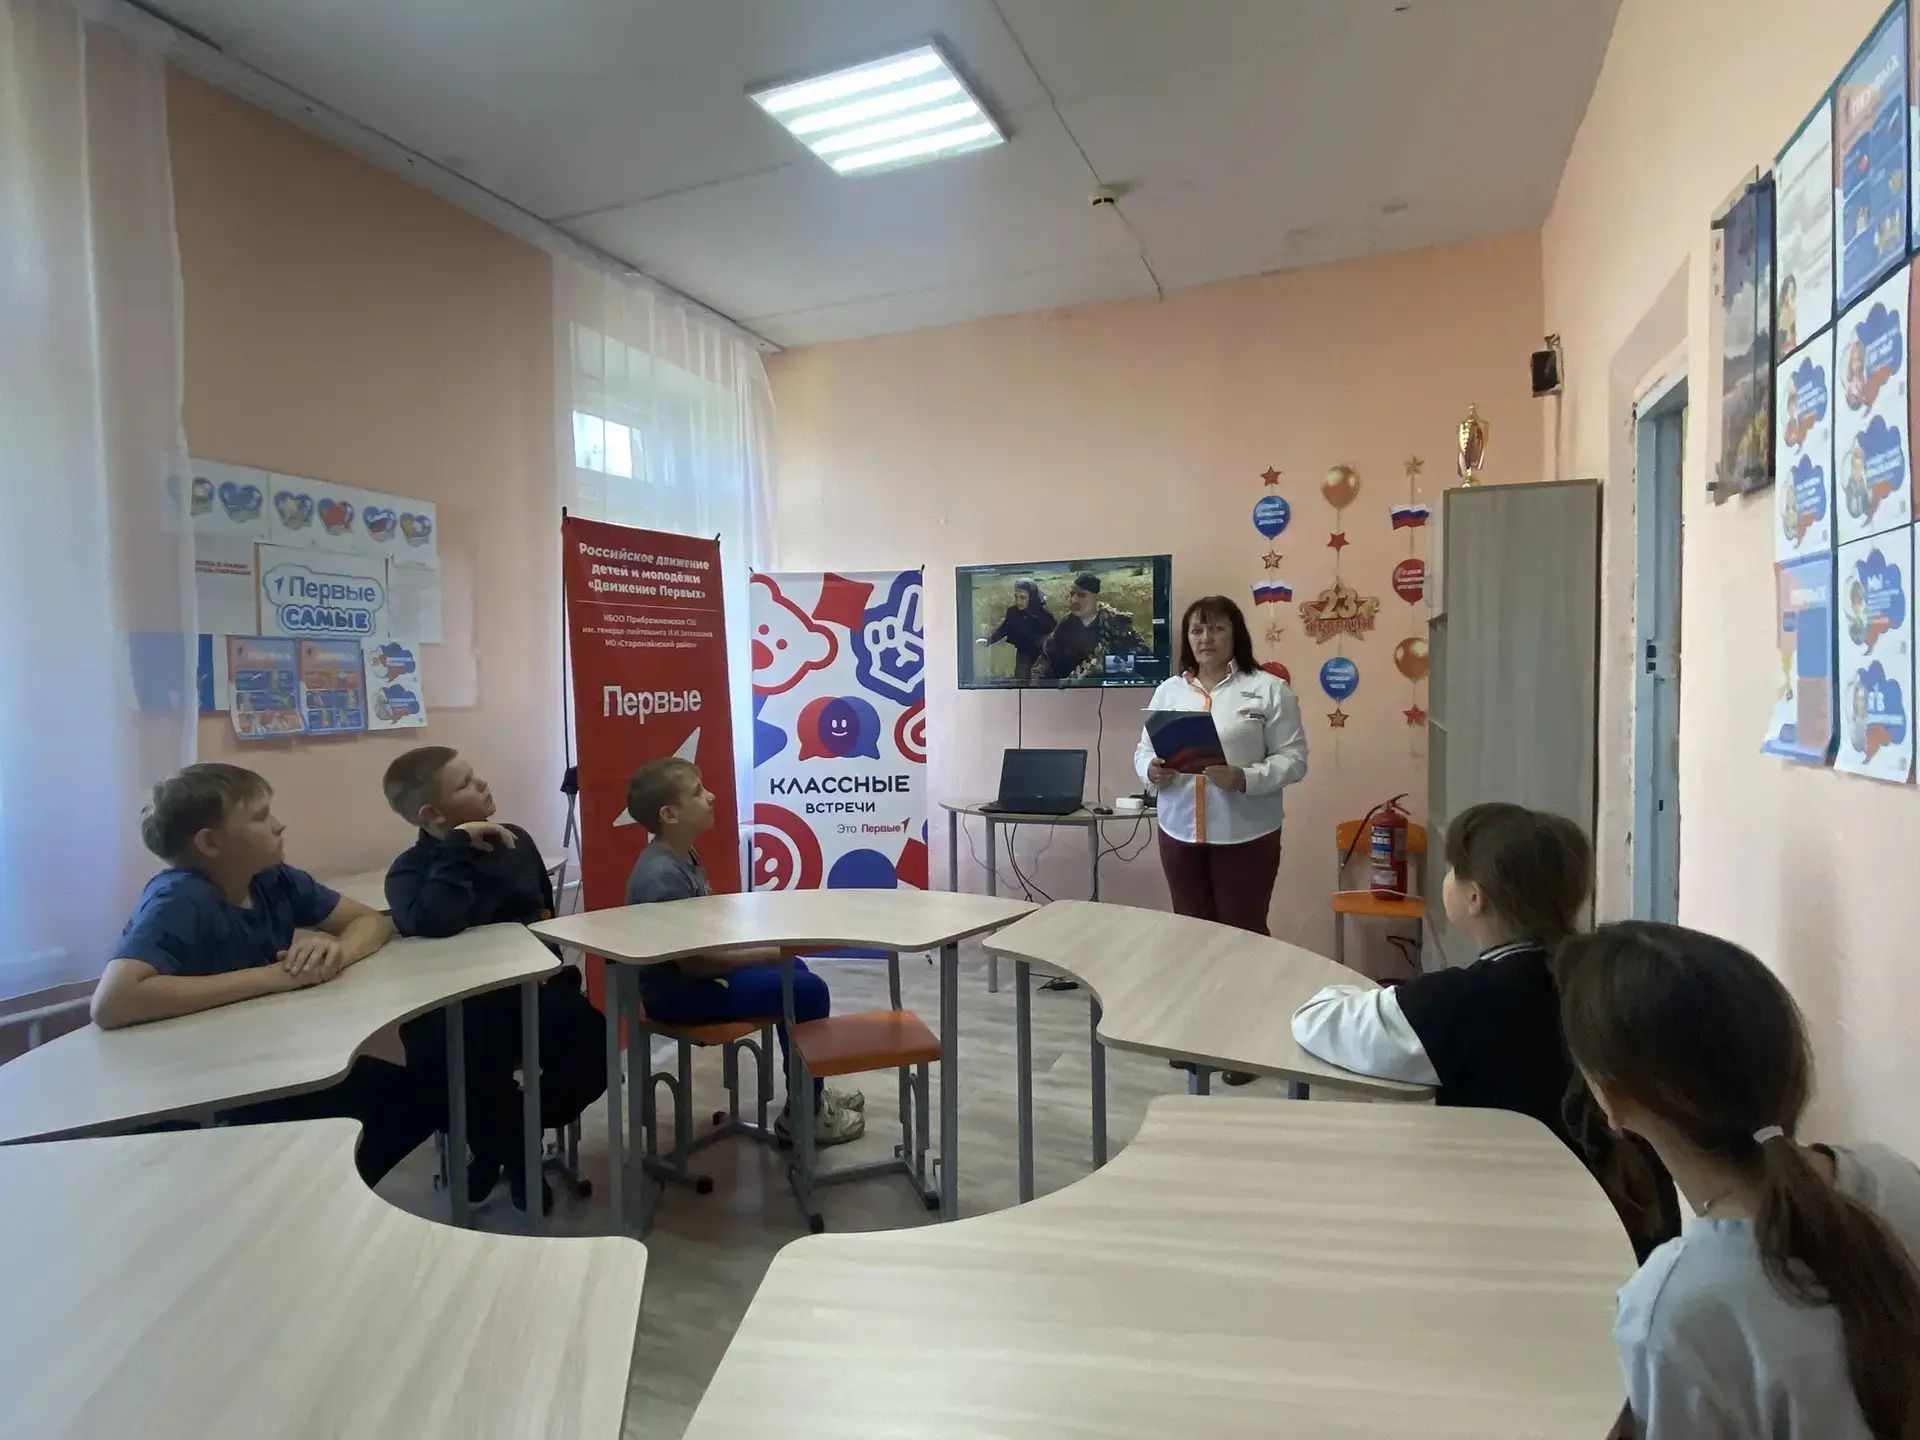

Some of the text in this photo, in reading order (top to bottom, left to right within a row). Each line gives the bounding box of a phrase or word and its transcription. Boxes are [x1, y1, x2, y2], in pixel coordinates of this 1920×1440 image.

[578, 542, 710, 570] Российское движение
[591, 563, 701, 584] детей и молодёжи
[289, 577, 376, 605] Первые
[588, 579, 706, 600] «Движение Первых»
[1319, 589, 1358, 620] 23
[286, 608, 370, 630] САМЫЕ
[603, 685, 702, 724] Первые
[770, 775, 910, 795] КЛАССНЫЕ
[805, 802, 876, 814] ВСТРЕЧИ
[837, 823, 901, 835] Это Первые
